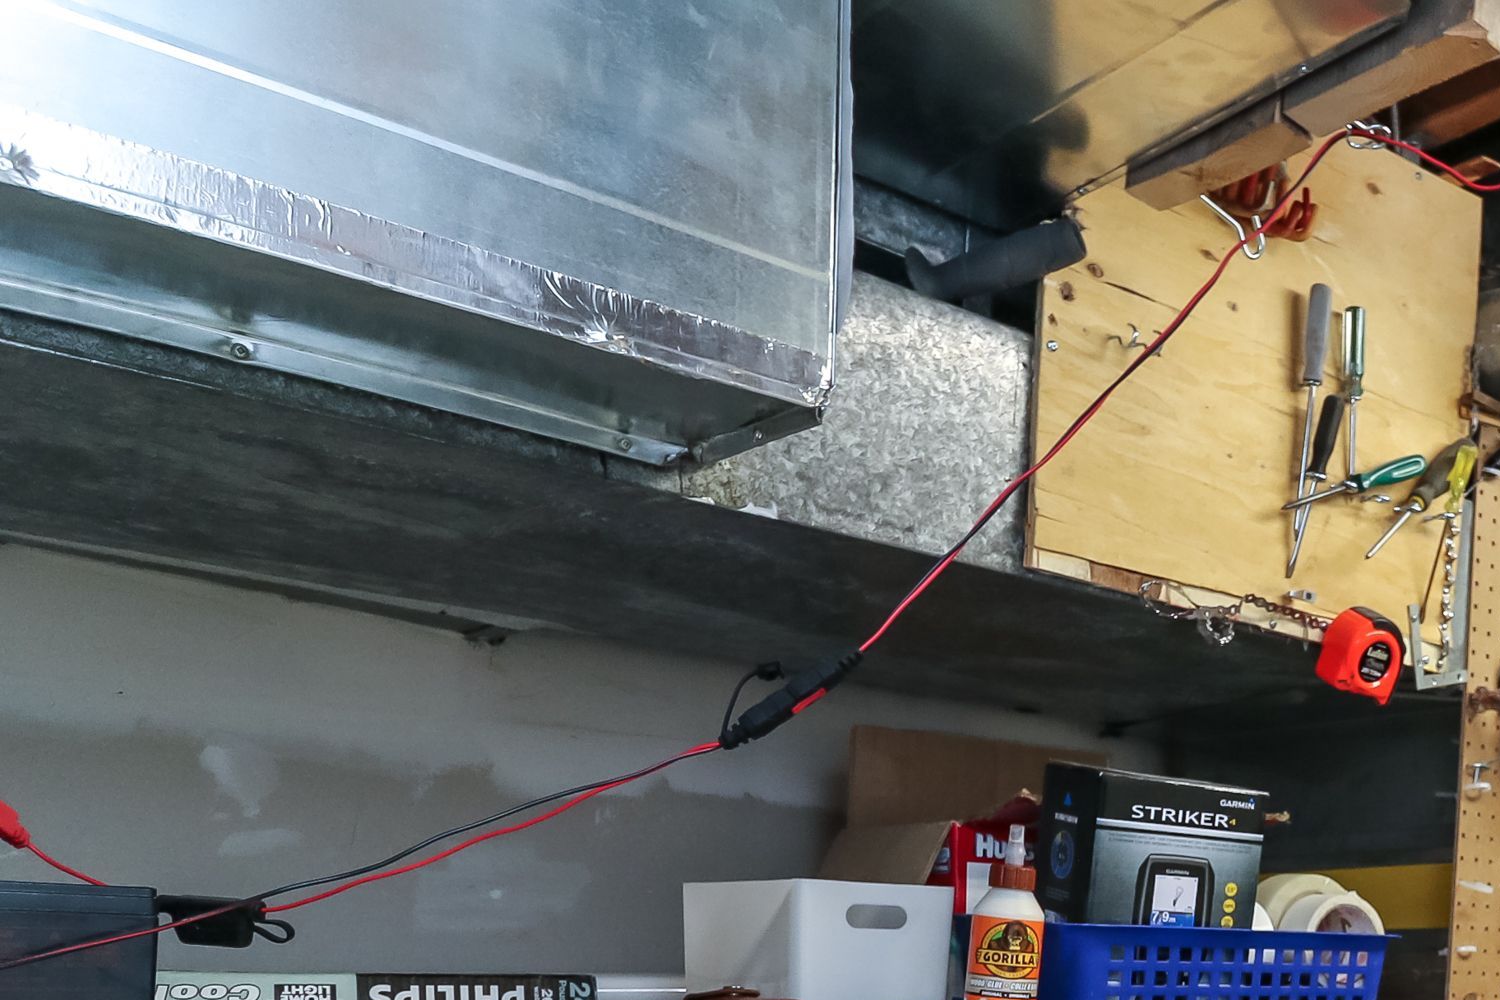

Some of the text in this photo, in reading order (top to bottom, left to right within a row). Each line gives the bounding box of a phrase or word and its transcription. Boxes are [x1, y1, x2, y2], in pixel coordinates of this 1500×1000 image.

[1219, 798, 1255, 810] GARMIN
[1131, 804, 1229, 828] STRIKER
[983, 951, 1035, 965] GORILLA
[281, 984, 331, 995] LIGHT
